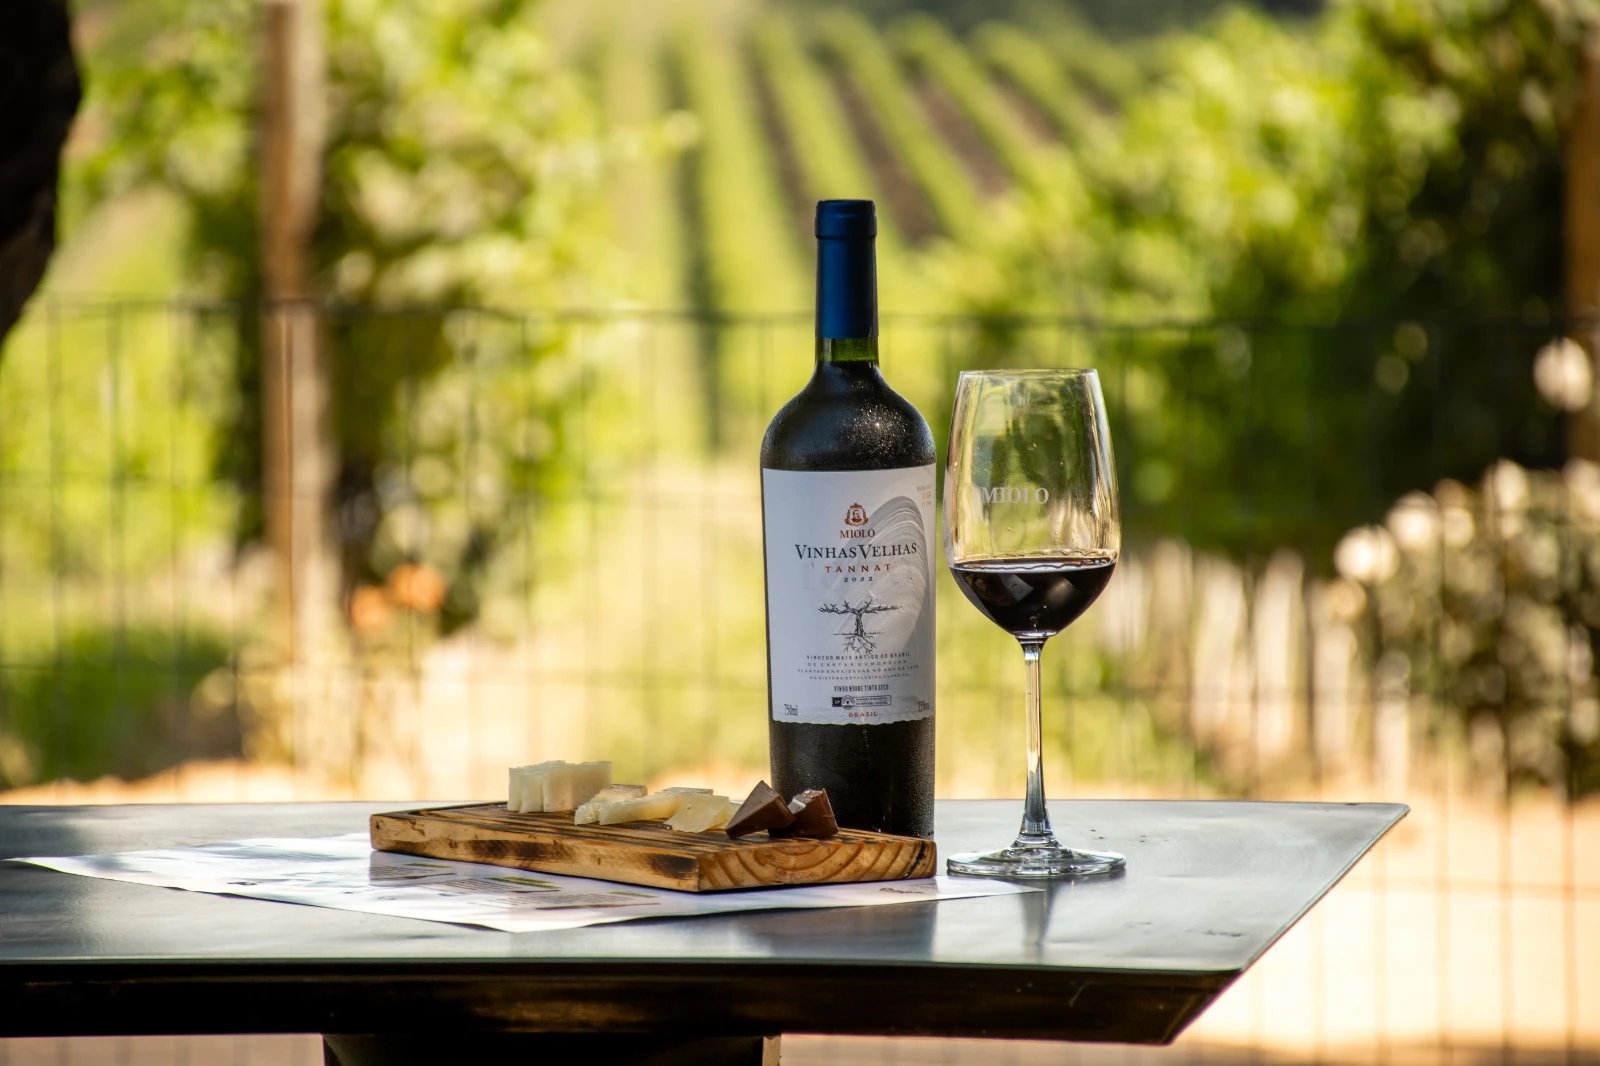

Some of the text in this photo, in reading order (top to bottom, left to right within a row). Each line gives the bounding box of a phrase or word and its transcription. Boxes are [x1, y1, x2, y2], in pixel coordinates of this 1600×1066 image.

[981, 486, 1049, 504] MIOLO
[840, 529, 875, 539] MIOLO
[794, 542, 917, 560] VINHAS VELHAS
[824, 563, 891, 573] TANNAT
